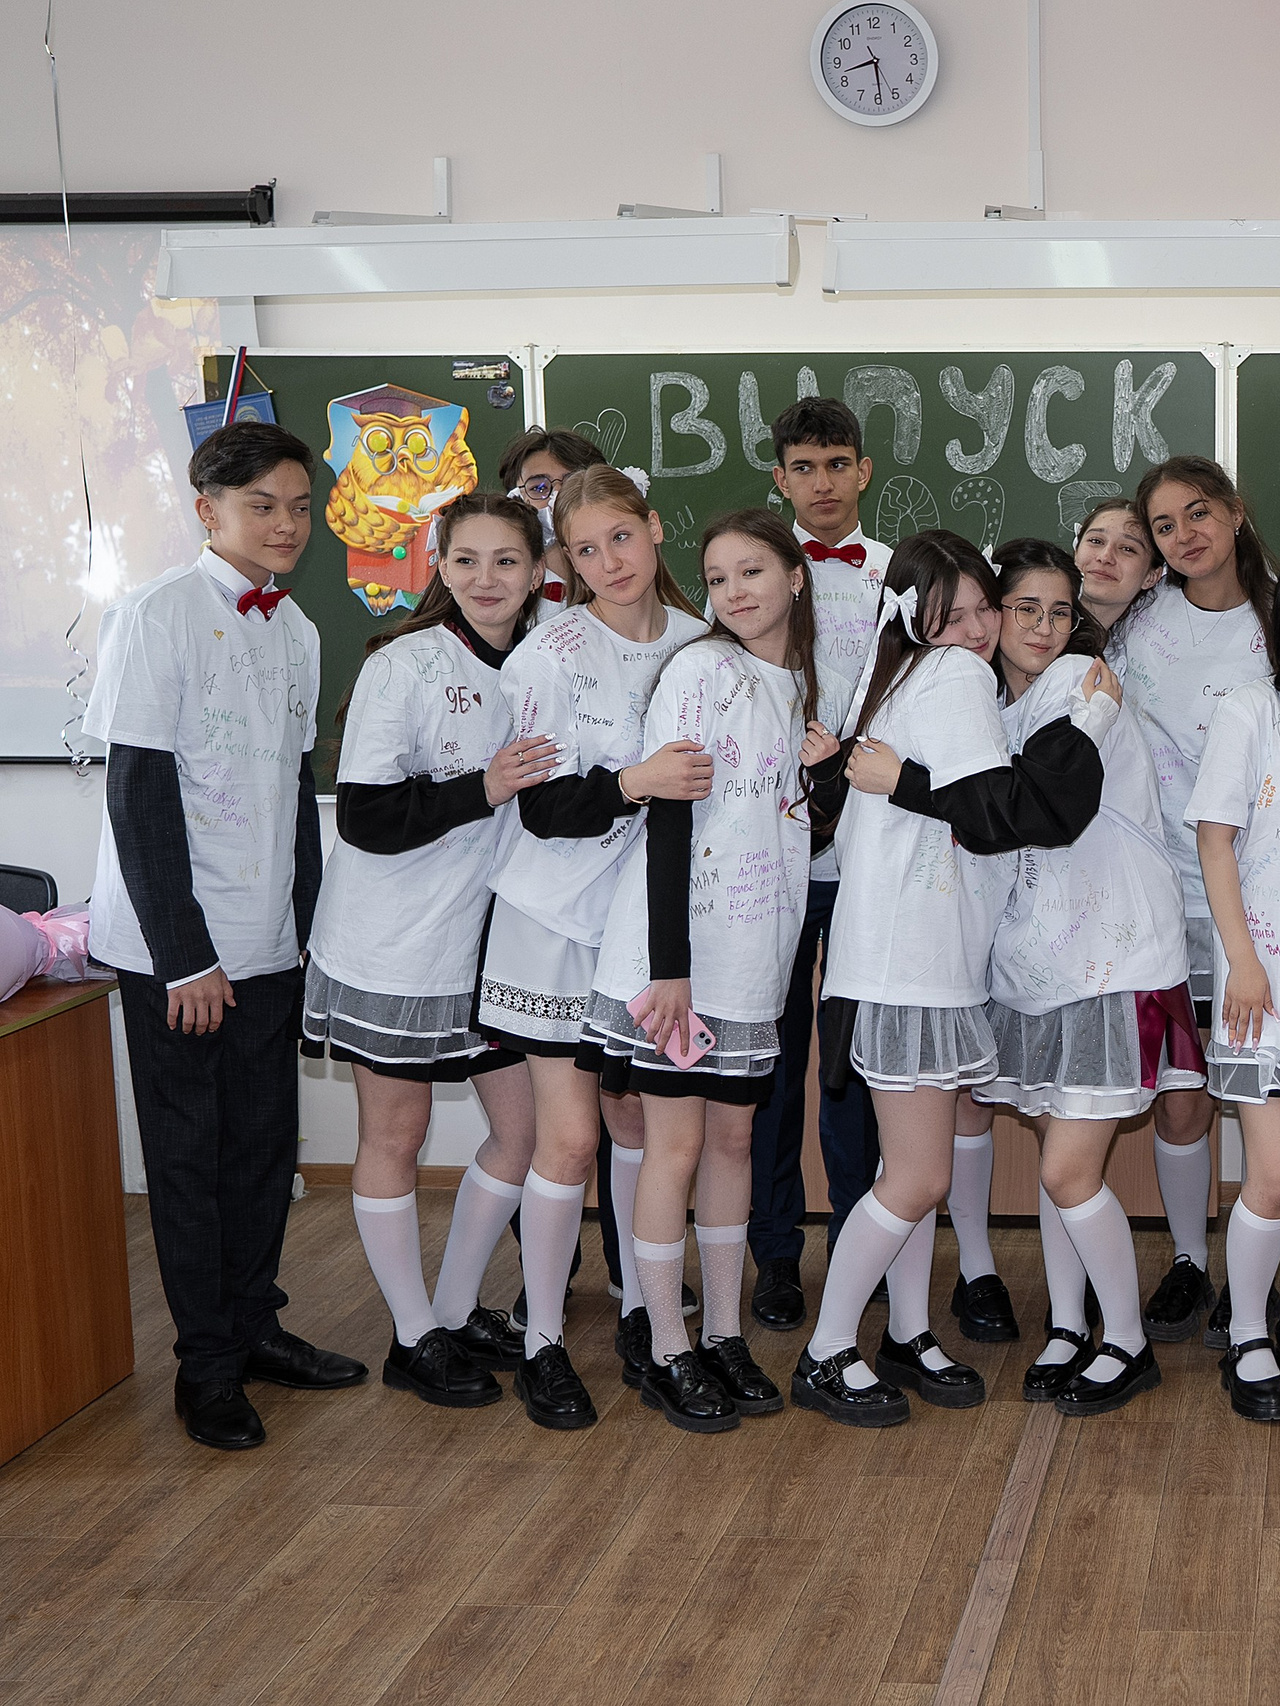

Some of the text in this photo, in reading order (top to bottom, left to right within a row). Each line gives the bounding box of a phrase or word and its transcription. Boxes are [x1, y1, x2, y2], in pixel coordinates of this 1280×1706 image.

[867, 17, 880, 29] 12
[890, 22, 896, 34] 1
[849, 24, 860, 35] 11
[838, 38, 851, 50] 10
[904, 35, 912, 47] 2
[833, 57, 841, 69] 9
[910, 53, 919, 65] 3
[840, 75, 849, 87] 8
[905, 73, 914, 84] 4
[857, 89, 865, 101] 7
[874, 93, 882, 105] 6
[892, 88, 900, 100] 5
[723, 770, 782, 802] РЫЦАРЬ
[1265, 785, 1276, 808] ТЕБЯ
